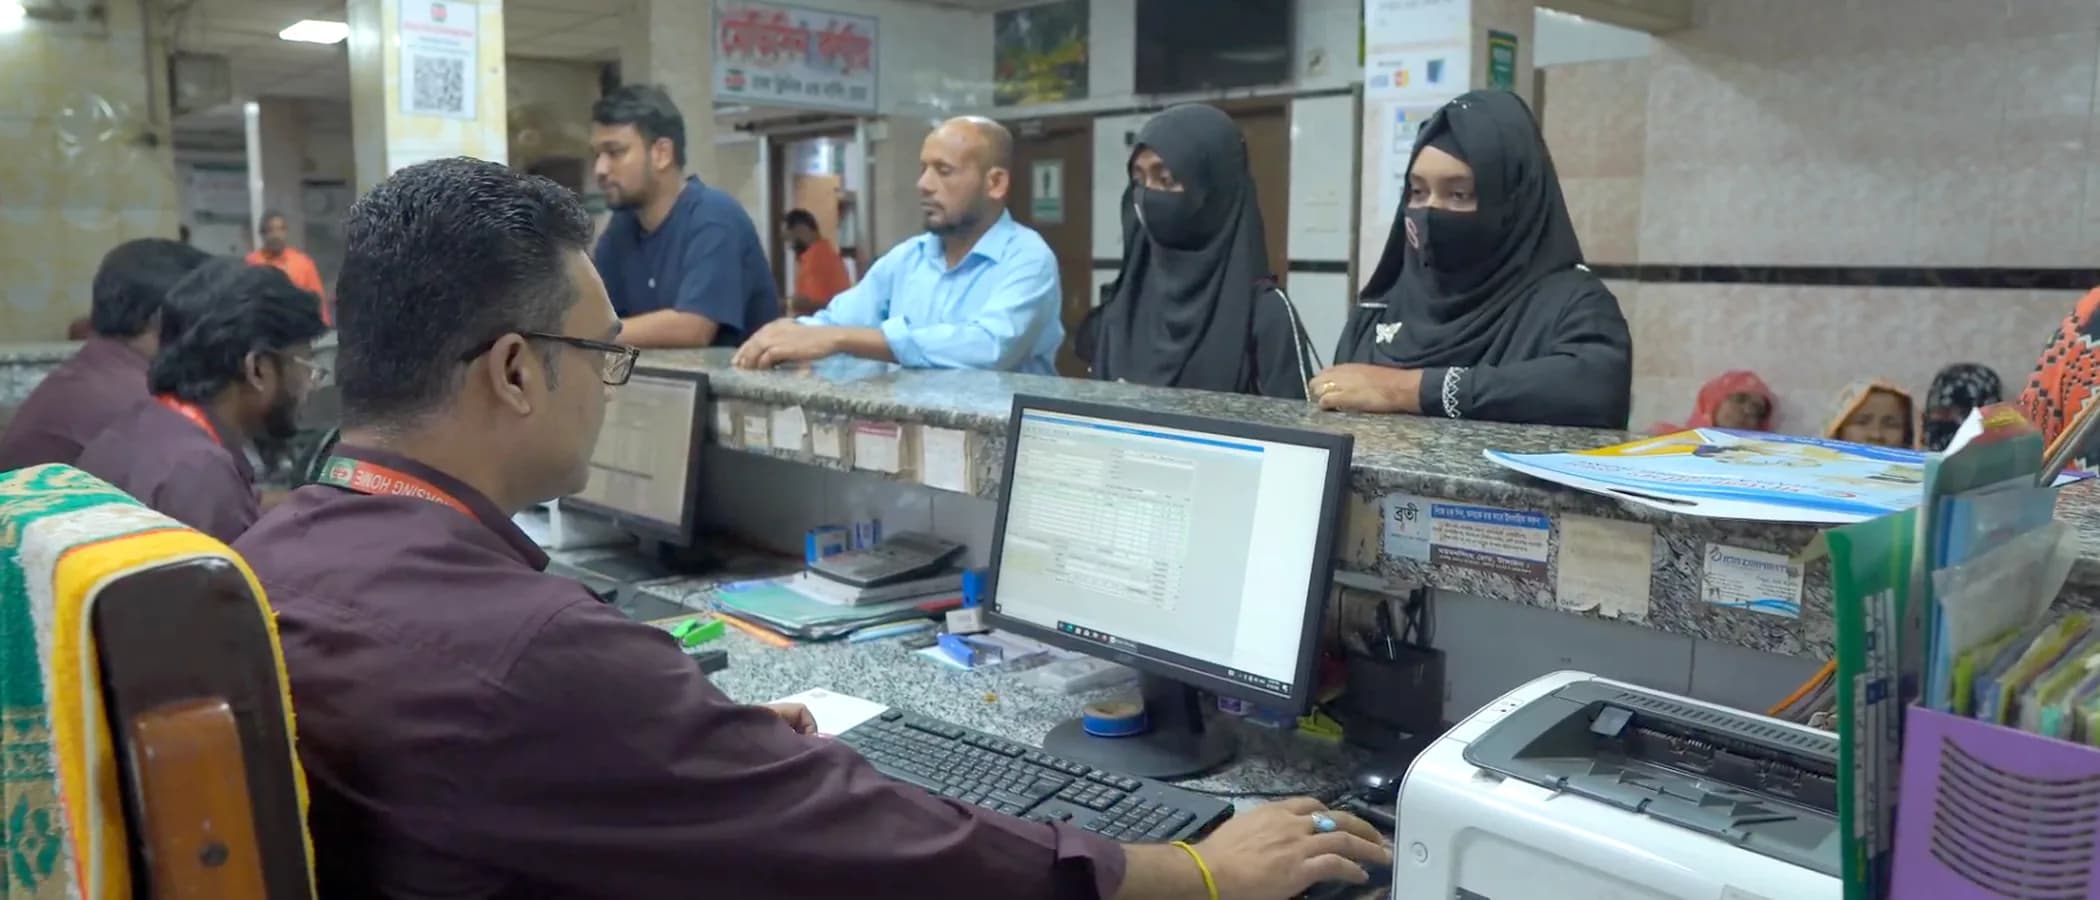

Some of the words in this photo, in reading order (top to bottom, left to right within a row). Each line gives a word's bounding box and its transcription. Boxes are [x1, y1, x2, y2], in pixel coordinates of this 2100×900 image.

[353, 469, 391, 491] HOME
[391, 481, 450, 504] SING
[1393, 502, 1419, 523] ব্রতী
